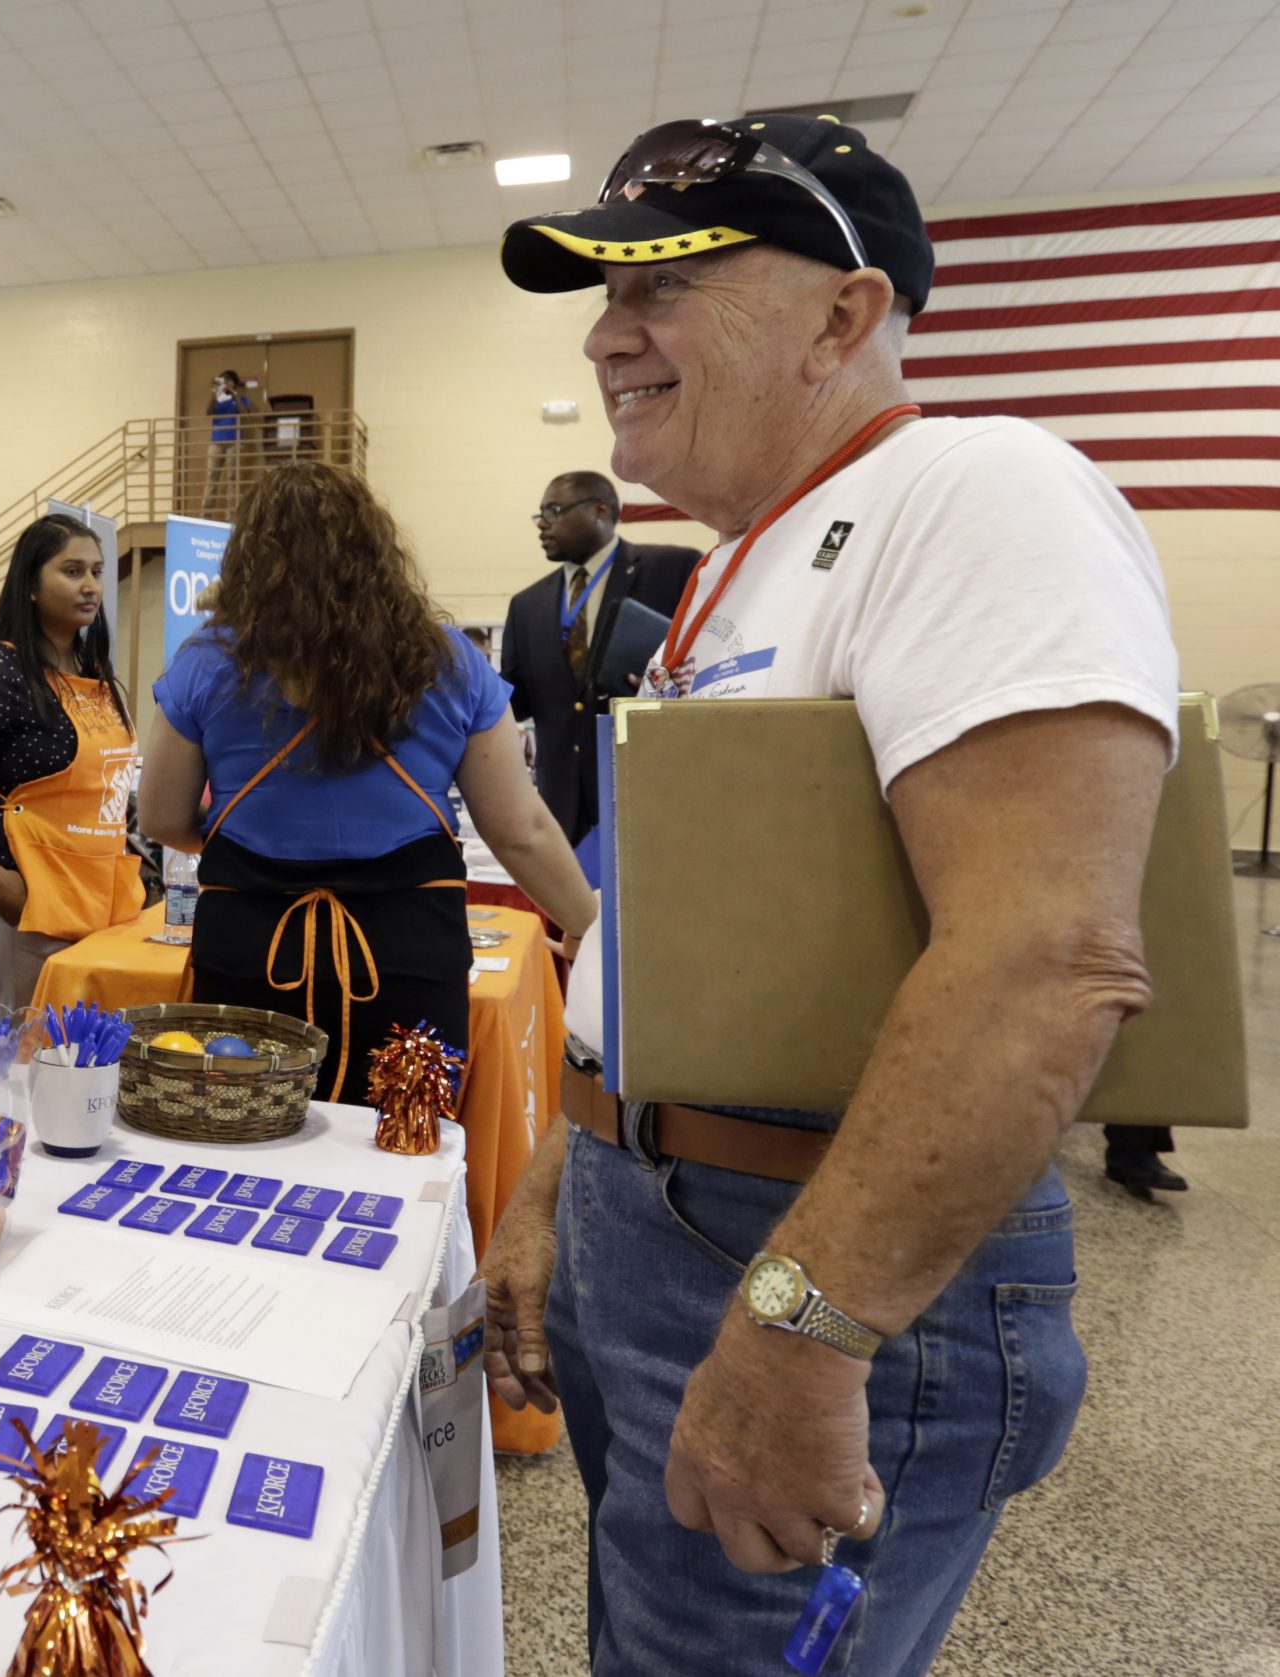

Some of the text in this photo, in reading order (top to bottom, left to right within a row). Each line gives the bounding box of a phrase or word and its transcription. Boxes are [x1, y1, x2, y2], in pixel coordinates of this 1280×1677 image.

[67, 824, 93, 835] More
[114, 1162, 144, 1184] KFORCE
[177, 1167, 207, 1189] KFORCE
[76, 1186, 113, 1210] KFORCE
[234, 1176, 260, 1198] KFORCE
[292, 1186, 321, 1209] KFORCE
[138, 1199, 173, 1224] KFORCE
[355, 1193, 381, 1217] KFORCE
[204, 1207, 237, 1233] KFORCE
[271, 1217, 300, 1244] KFORCE
[342, 1230, 373, 1257] KFORCE
[8, 1340, 56, 1381] KFORCE
[96, 1362, 139, 1405] KFORCE
[180, 1376, 219, 1422] KFORCE
[423, 1421, 456, 1453] rce
[143, 1442, 185, 1496] KFORCE
[255, 1460, 291, 1518] KFORCE
